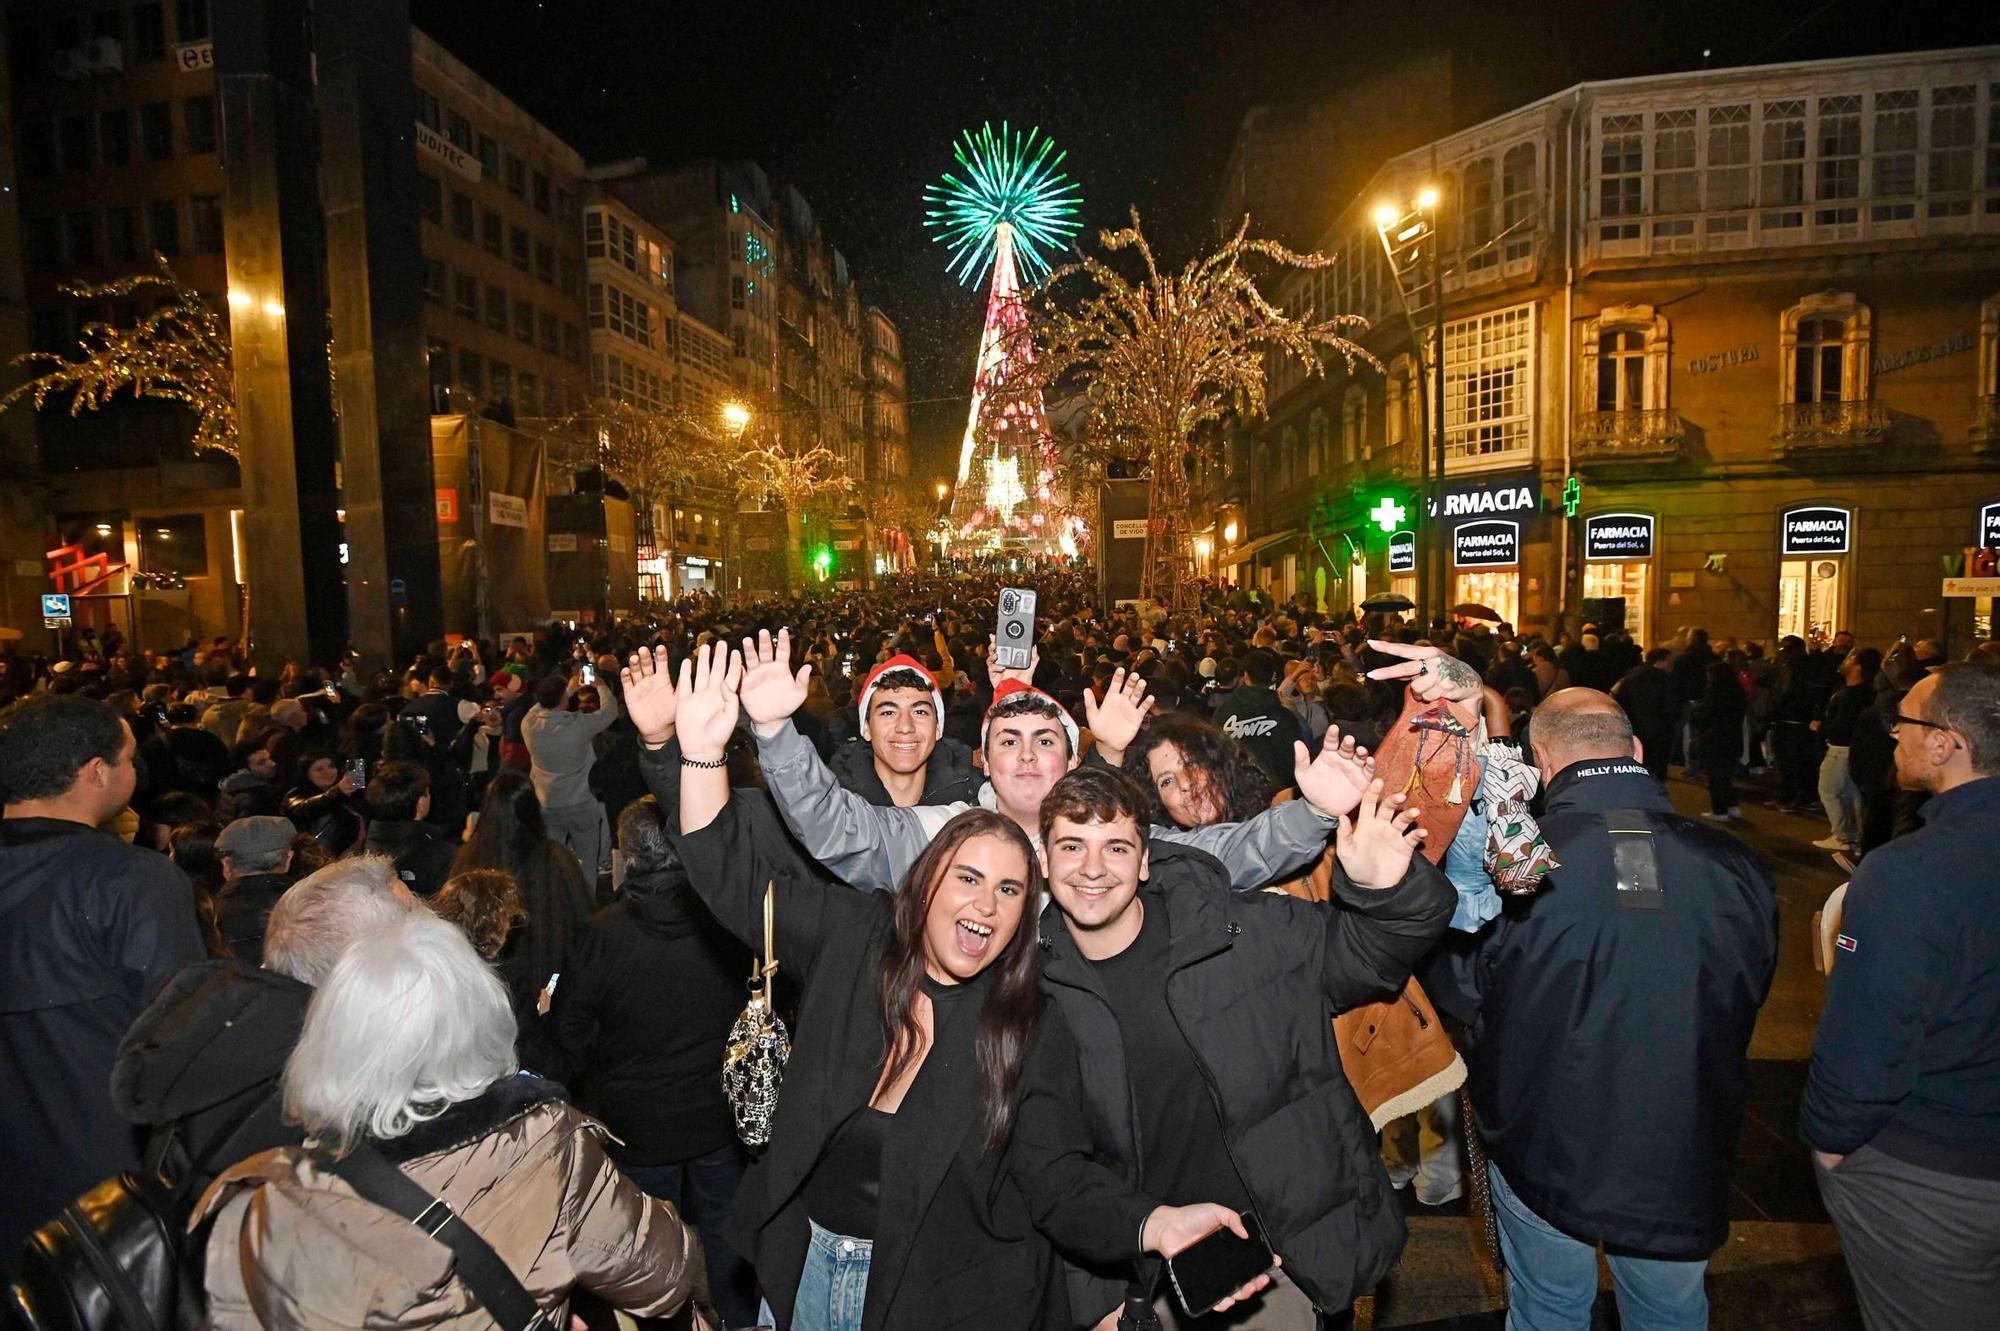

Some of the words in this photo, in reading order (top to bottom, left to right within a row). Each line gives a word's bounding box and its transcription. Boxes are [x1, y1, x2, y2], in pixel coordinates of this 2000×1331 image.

[418, 127, 465, 169] UDITEC
[1590, 526, 1649, 539] FARMACIA
[1788, 520, 1845, 533] FARMACIA
[1457, 533, 1514, 548] FARMACIA
[1482, 549, 1492, 557] del
[1577, 765, 1611, 778] HELLY
